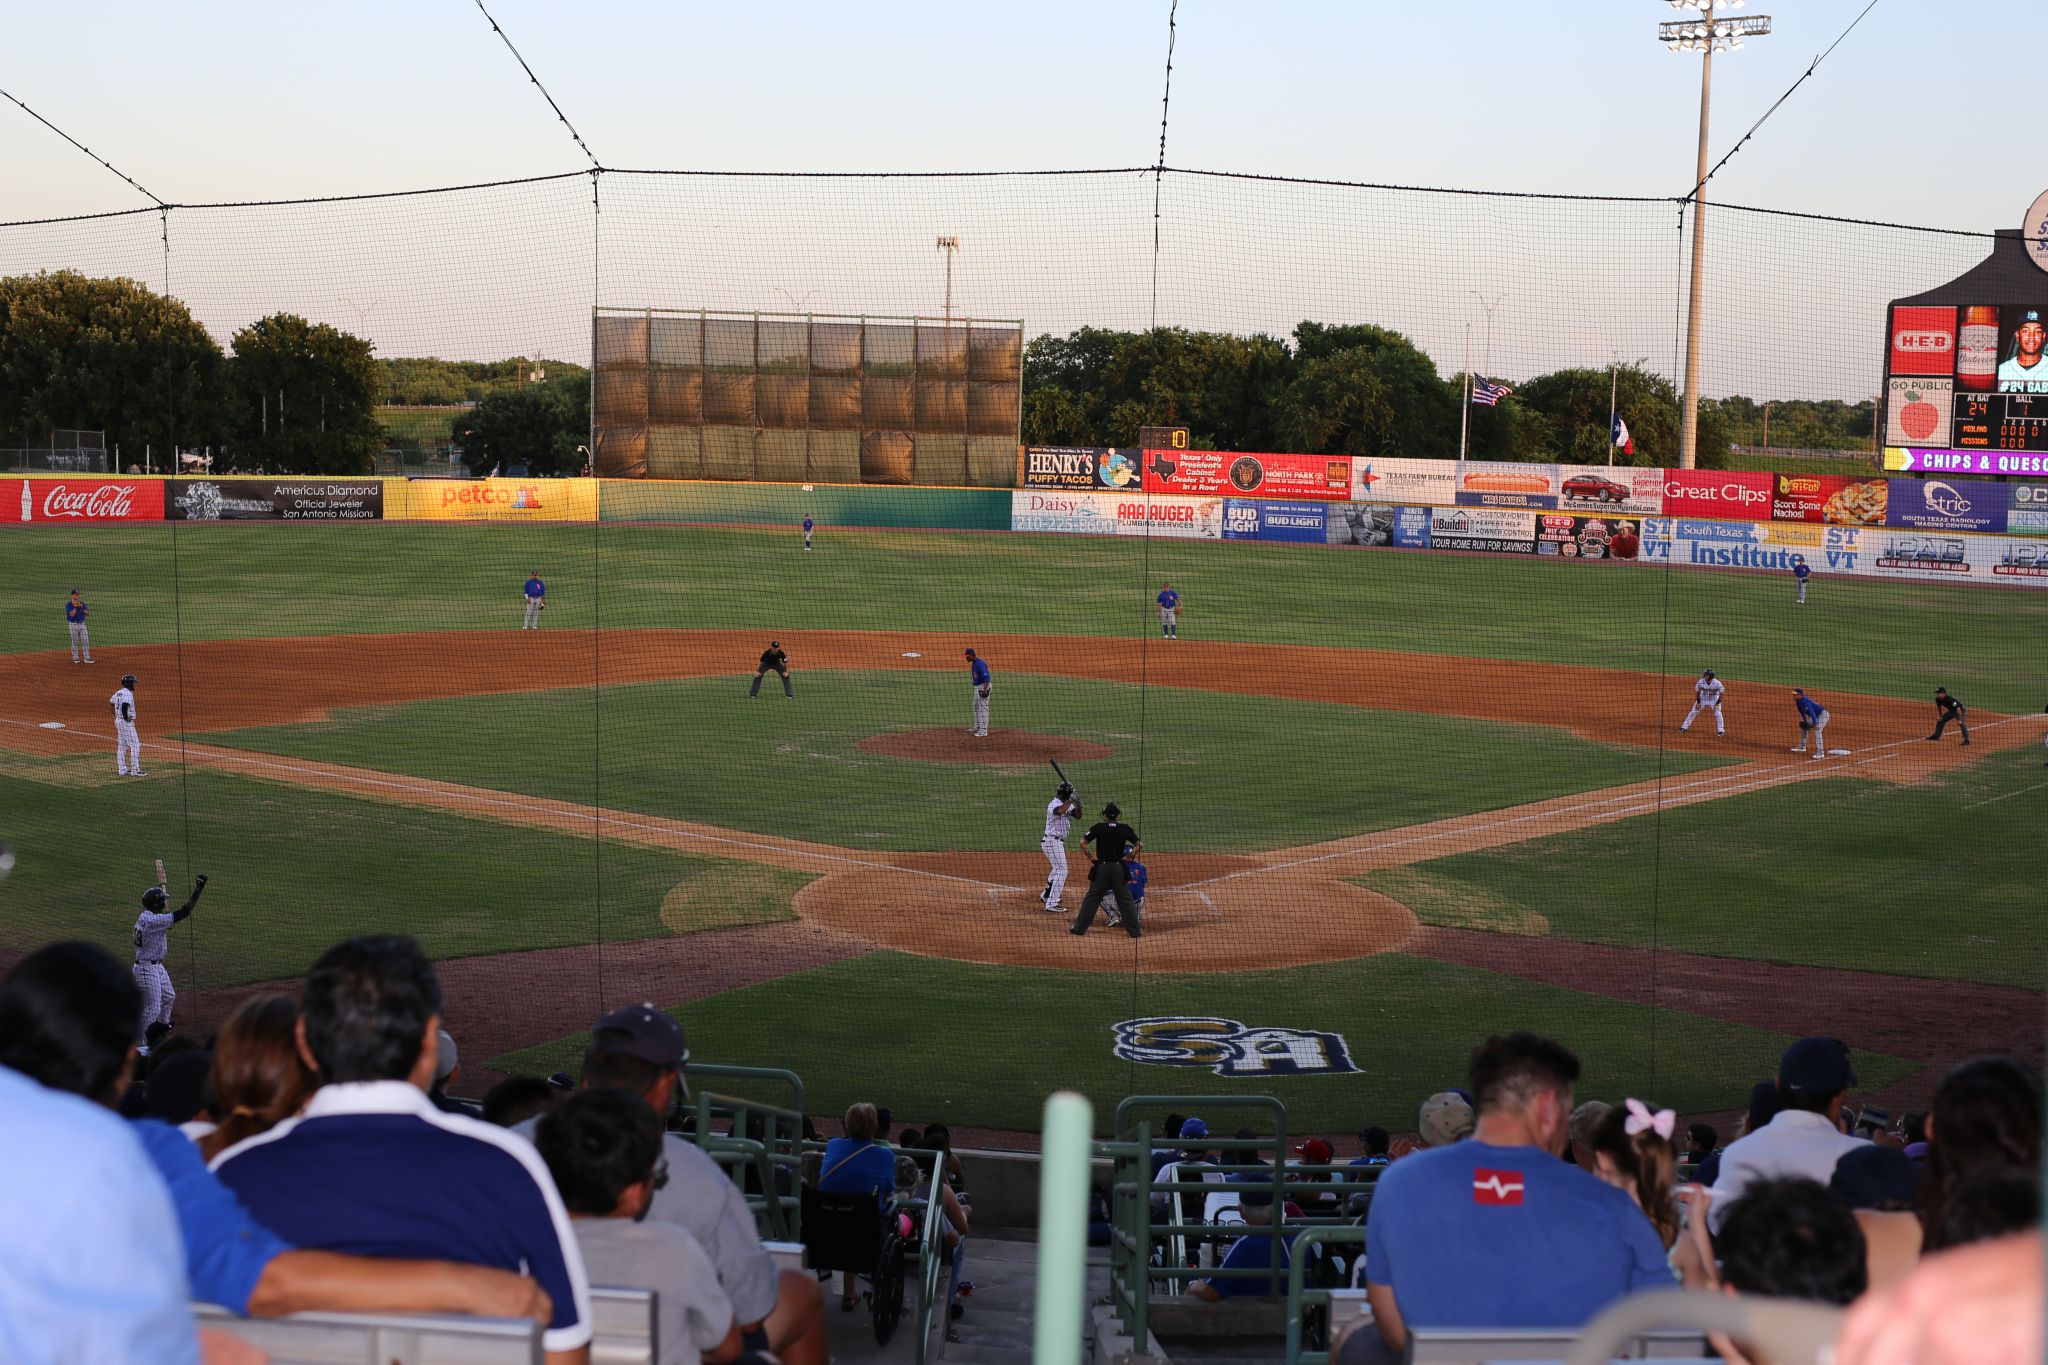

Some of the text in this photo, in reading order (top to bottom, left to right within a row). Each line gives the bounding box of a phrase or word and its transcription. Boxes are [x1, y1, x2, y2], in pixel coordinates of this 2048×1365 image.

[1891, 381, 1952, 391] GO PUBLIC
[1967, 394, 1990, 402] AT BAT
[2015, 395, 2033, 403] BALL
[1969, 402, 1987, 416] 24
[1963, 425, 1988, 433] MIDLAND
[1961, 437, 1988, 445] MISSIONS
[1205, 454, 1222, 462] Only
[1923, 453, 1972, 469] CHIPS
[1980, 455, 1990, 469] &
[1029, 453, 1093, 475] HENRY'S
[1028, 475, 1093, 484] PUFFY TACOS
[1172, 475, 1198, 483] Dealer
[1265, 470, 1314, 479] NORTH PARK
[274, 484, 378, 496] Americus Diamond
[1664, 481, 1767, 506] Great Clips
[441, 485, 511, 508] petco
[294, 499, 364, 509] Official Jeweler
[1031, 495, 1077, 516] Daisy
[1773, 499, 1821, 510] Score Some
[1925, 496, 1972, 512] stric
[283, 509, 374, 519] San Antonio Missions
[1117, 503, 1194, 521] AAA AUGER
[1227, 507, 1257, 520] BUD
[1480, 511, 1530, 520] CUSTOM HOMES
[1773, 509, 1805, 519] Nachos!
[1016, 516, 1113, 532] 210-225-8600
[1118, 519, 1156, 527] PLUMBING
[1223, 519, 1259, 532] LIGHT
[1267, 516, 1320, 527] BUD LIGHT
[1480, 520, 1504, 528] EXPERT
[1644, 518, 1672, 535] ST
[1950, 517, 1991, 525] RADIOLOGY
[1480, 528, 1533, 538] OWNER CONTROL
[1544, 527, 1558, 535] JULY
[1683, 524, 1743, 538] South Texas
[1827, 527, 1860, 545] ST
[1539, 534, 1575, 542] CELEBRATION
[1432, 537, 1451, 548] YOUR
[1451, 538, 1471, 549] HOME
[1472, 540, 1487, 550] RUN
[1487, 540, 1502, 551] FOR
[1502, 541, 1534, 553] SAVINGS!
[1643, 540, 1672, 557] VT
[1691, 541, 1805, 568] Institute
[1826, 551, 1858, 569] VT
